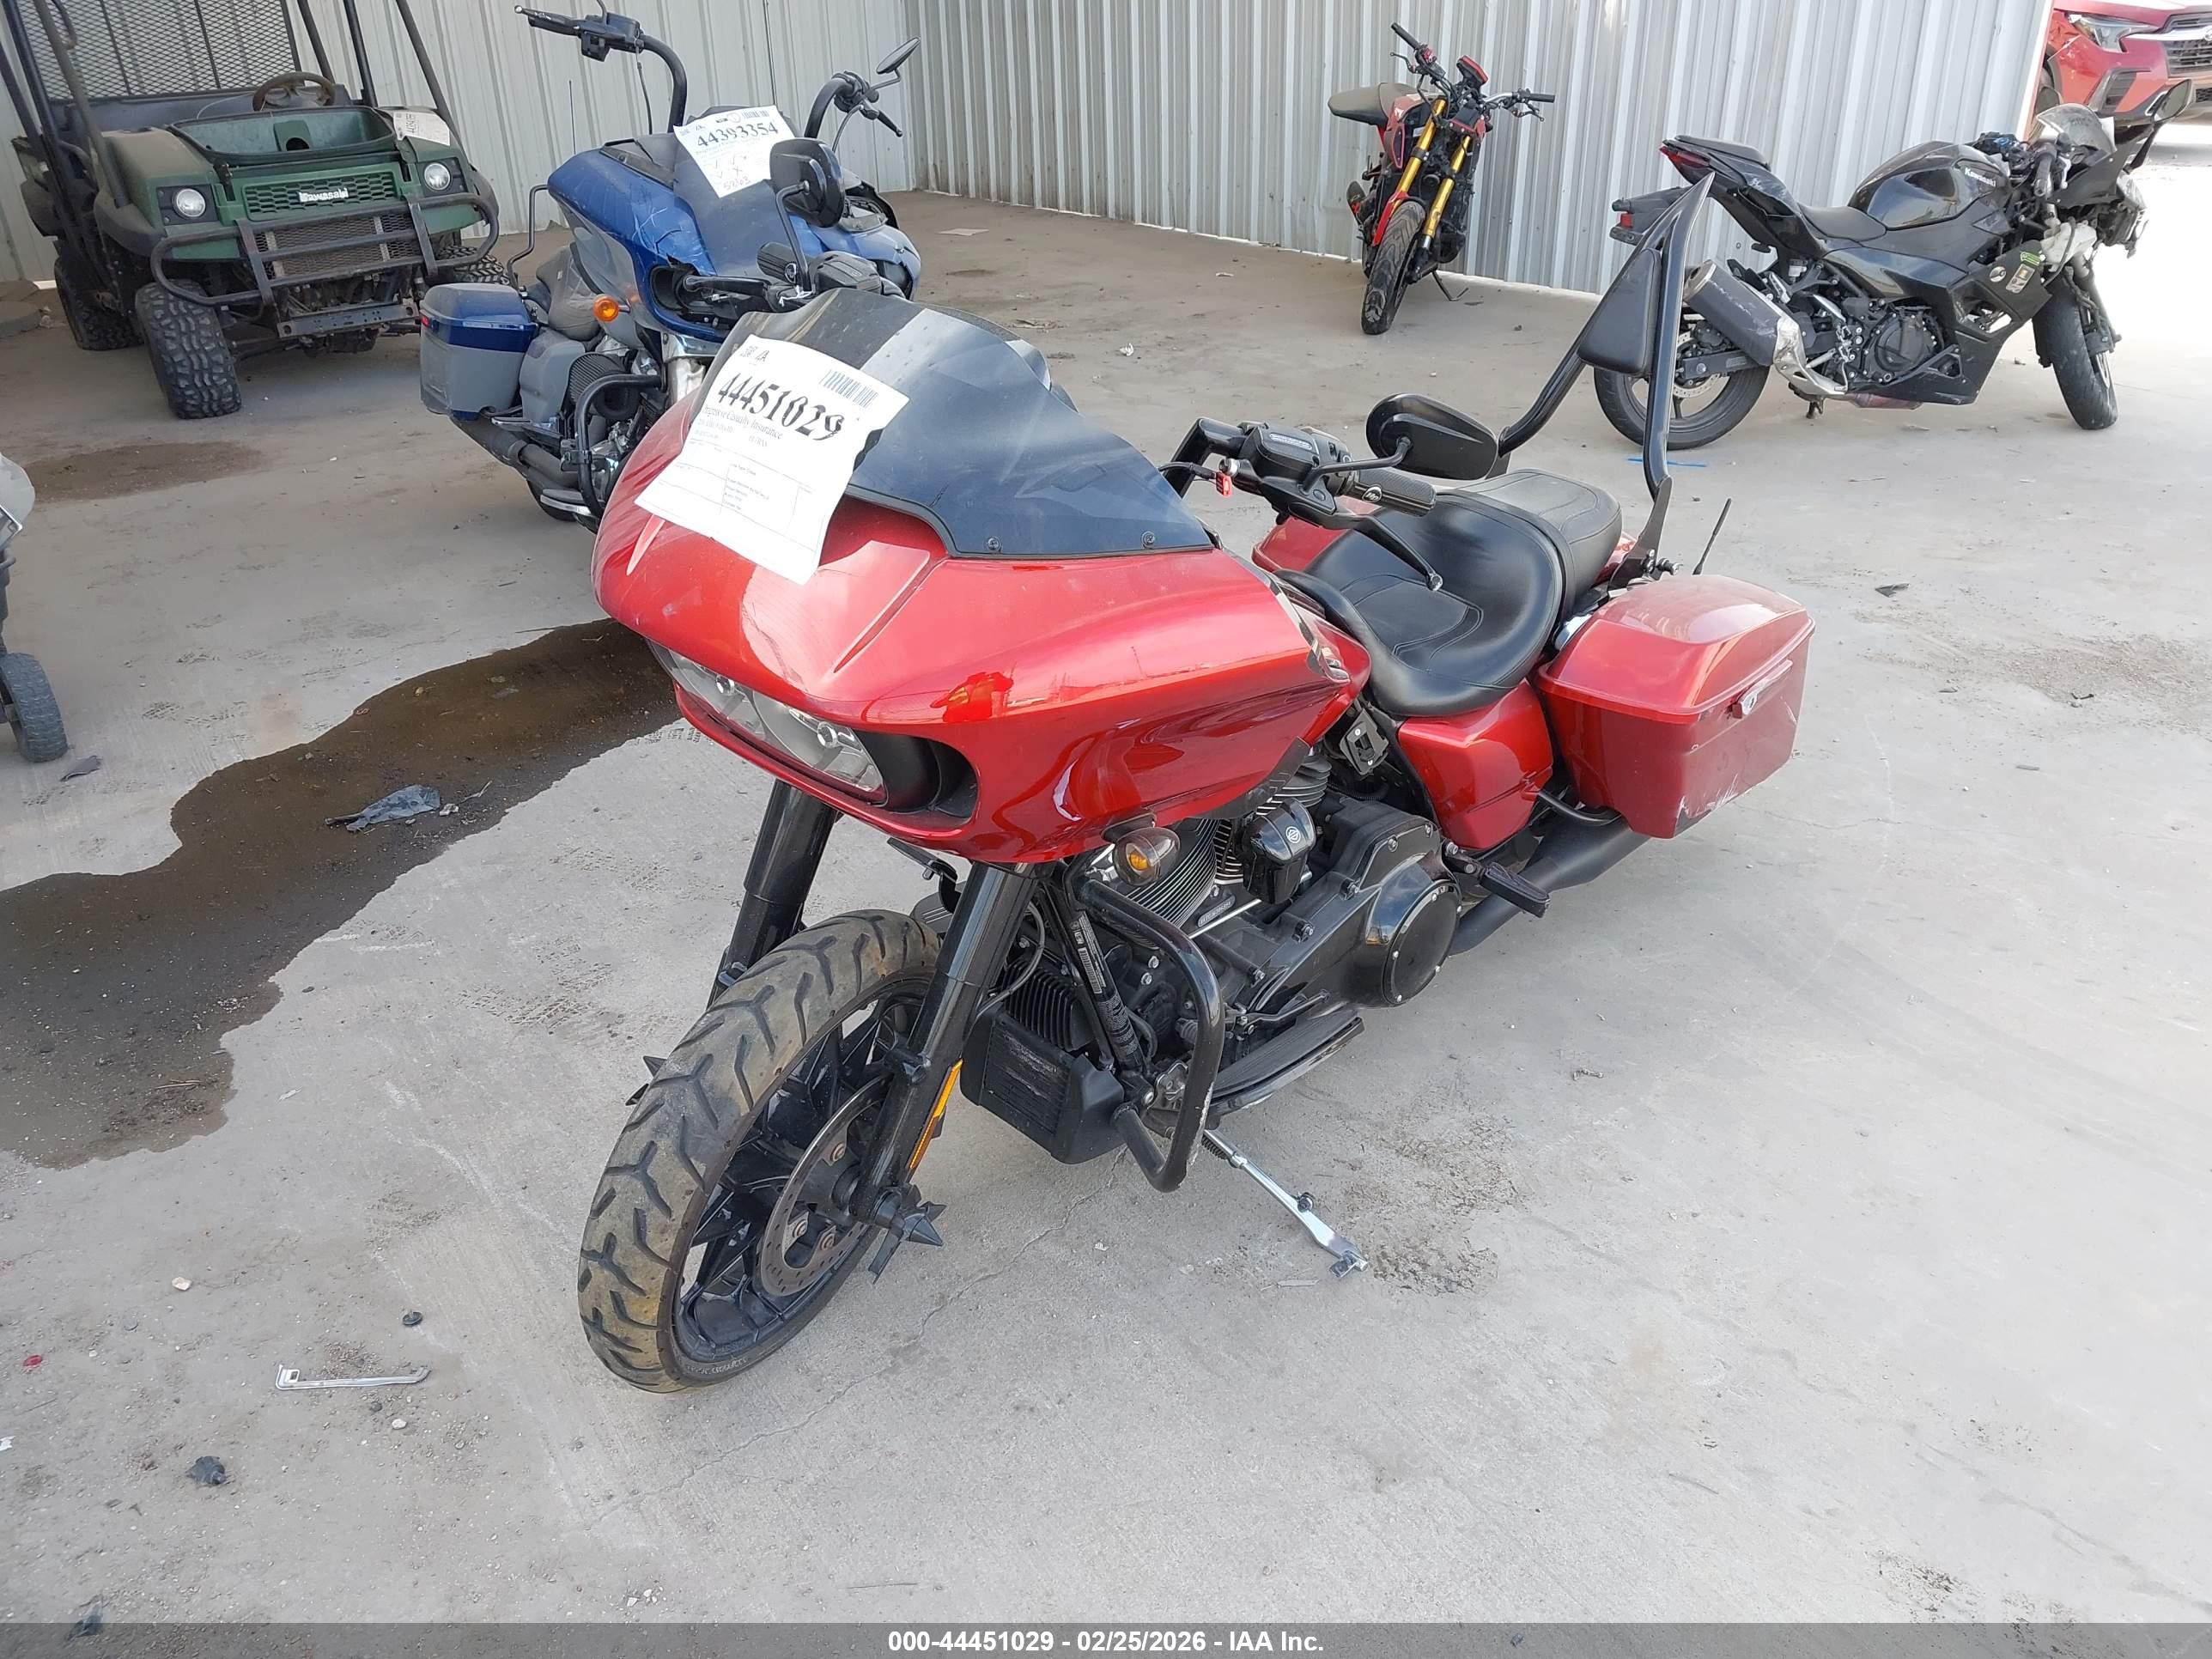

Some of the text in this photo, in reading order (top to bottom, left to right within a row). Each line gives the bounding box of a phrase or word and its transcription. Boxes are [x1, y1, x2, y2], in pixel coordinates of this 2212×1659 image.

[697, 121, 779, 147] 44393354
[1965, 167, 1996, 188] Kawasaki
[298, 187, 349, 203] Kawasaki
[718, 372, 845, 441] 44451029
[750, 417, 784, 441] Insurance
